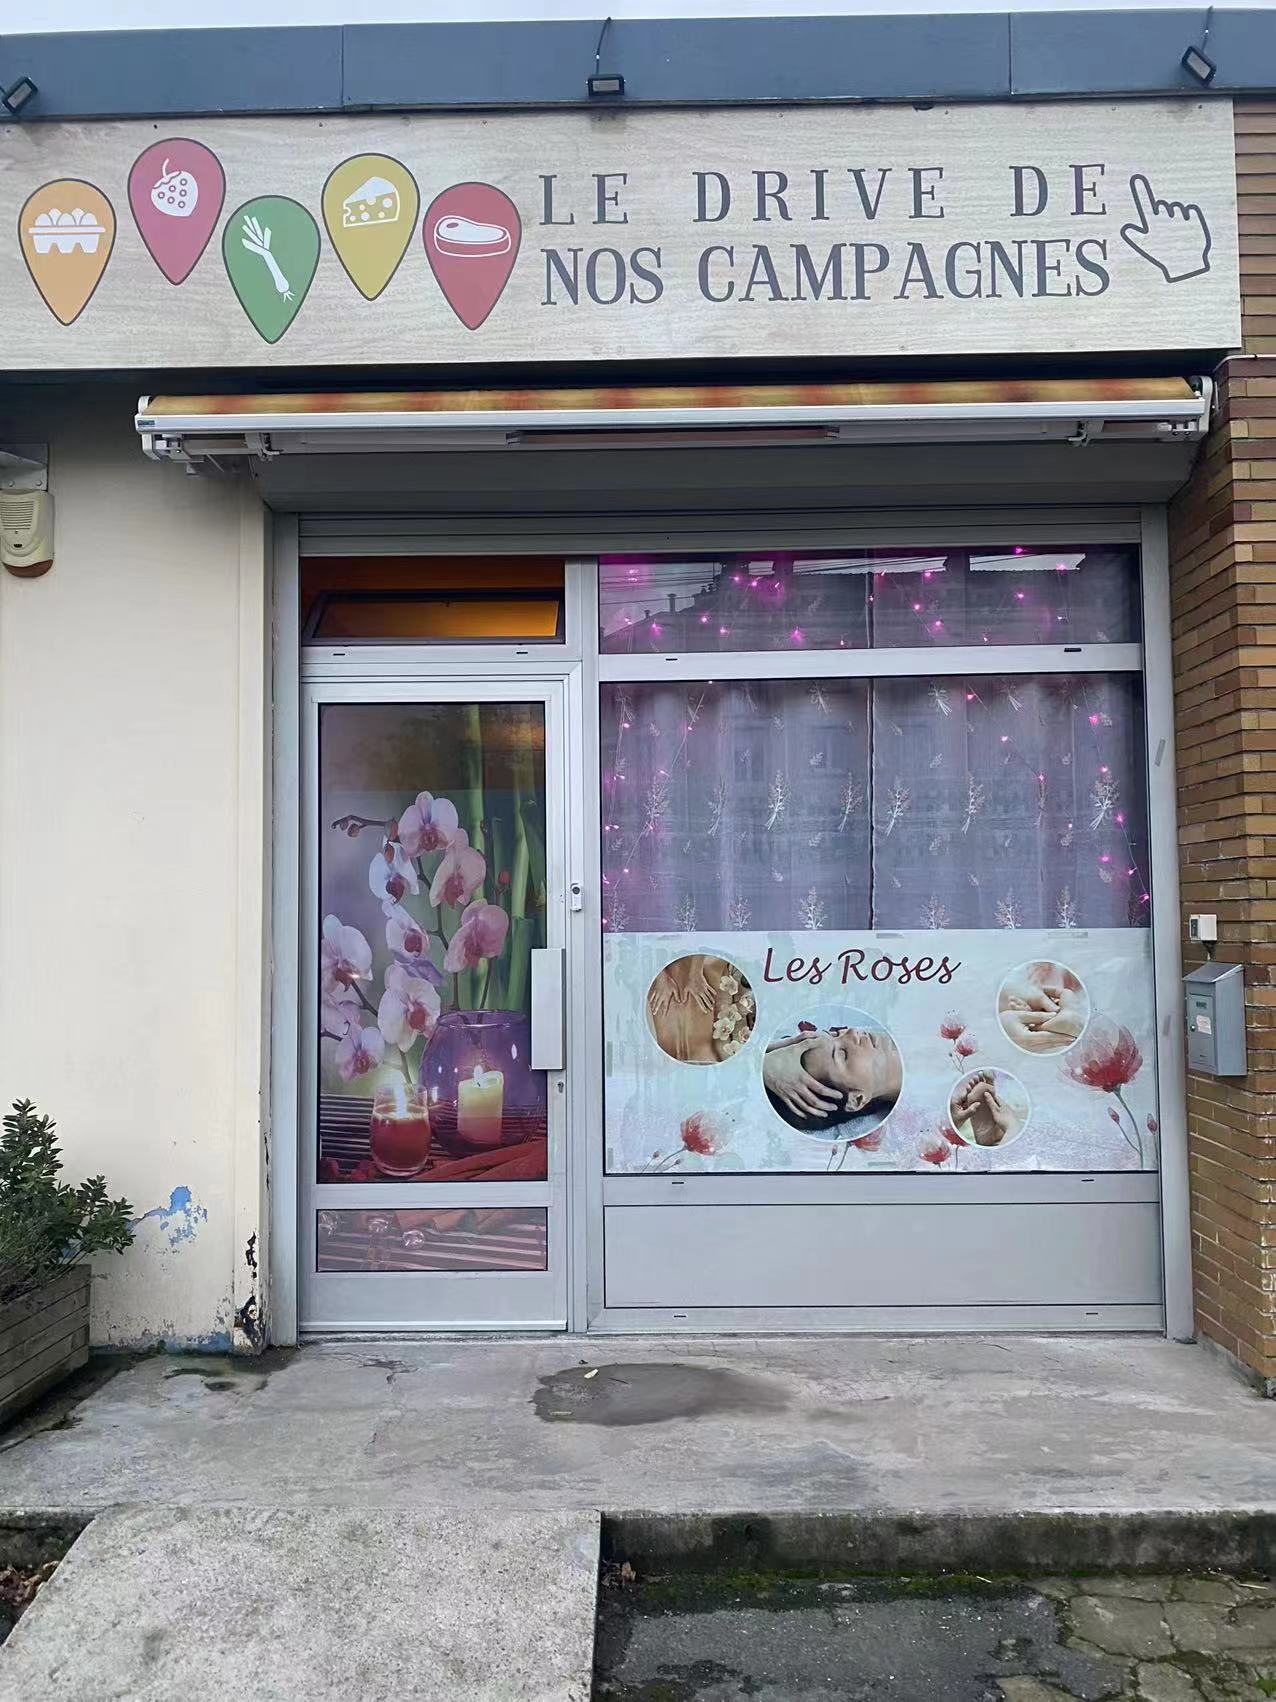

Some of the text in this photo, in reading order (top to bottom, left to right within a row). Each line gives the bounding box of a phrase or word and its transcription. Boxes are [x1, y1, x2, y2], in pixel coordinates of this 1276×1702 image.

[538, 163, 1107, 227] LE DRIVE DE
[540, 238, 1111, 306] NOS CAMPAGNES
[763, 947, 962, 985] Les Roses
